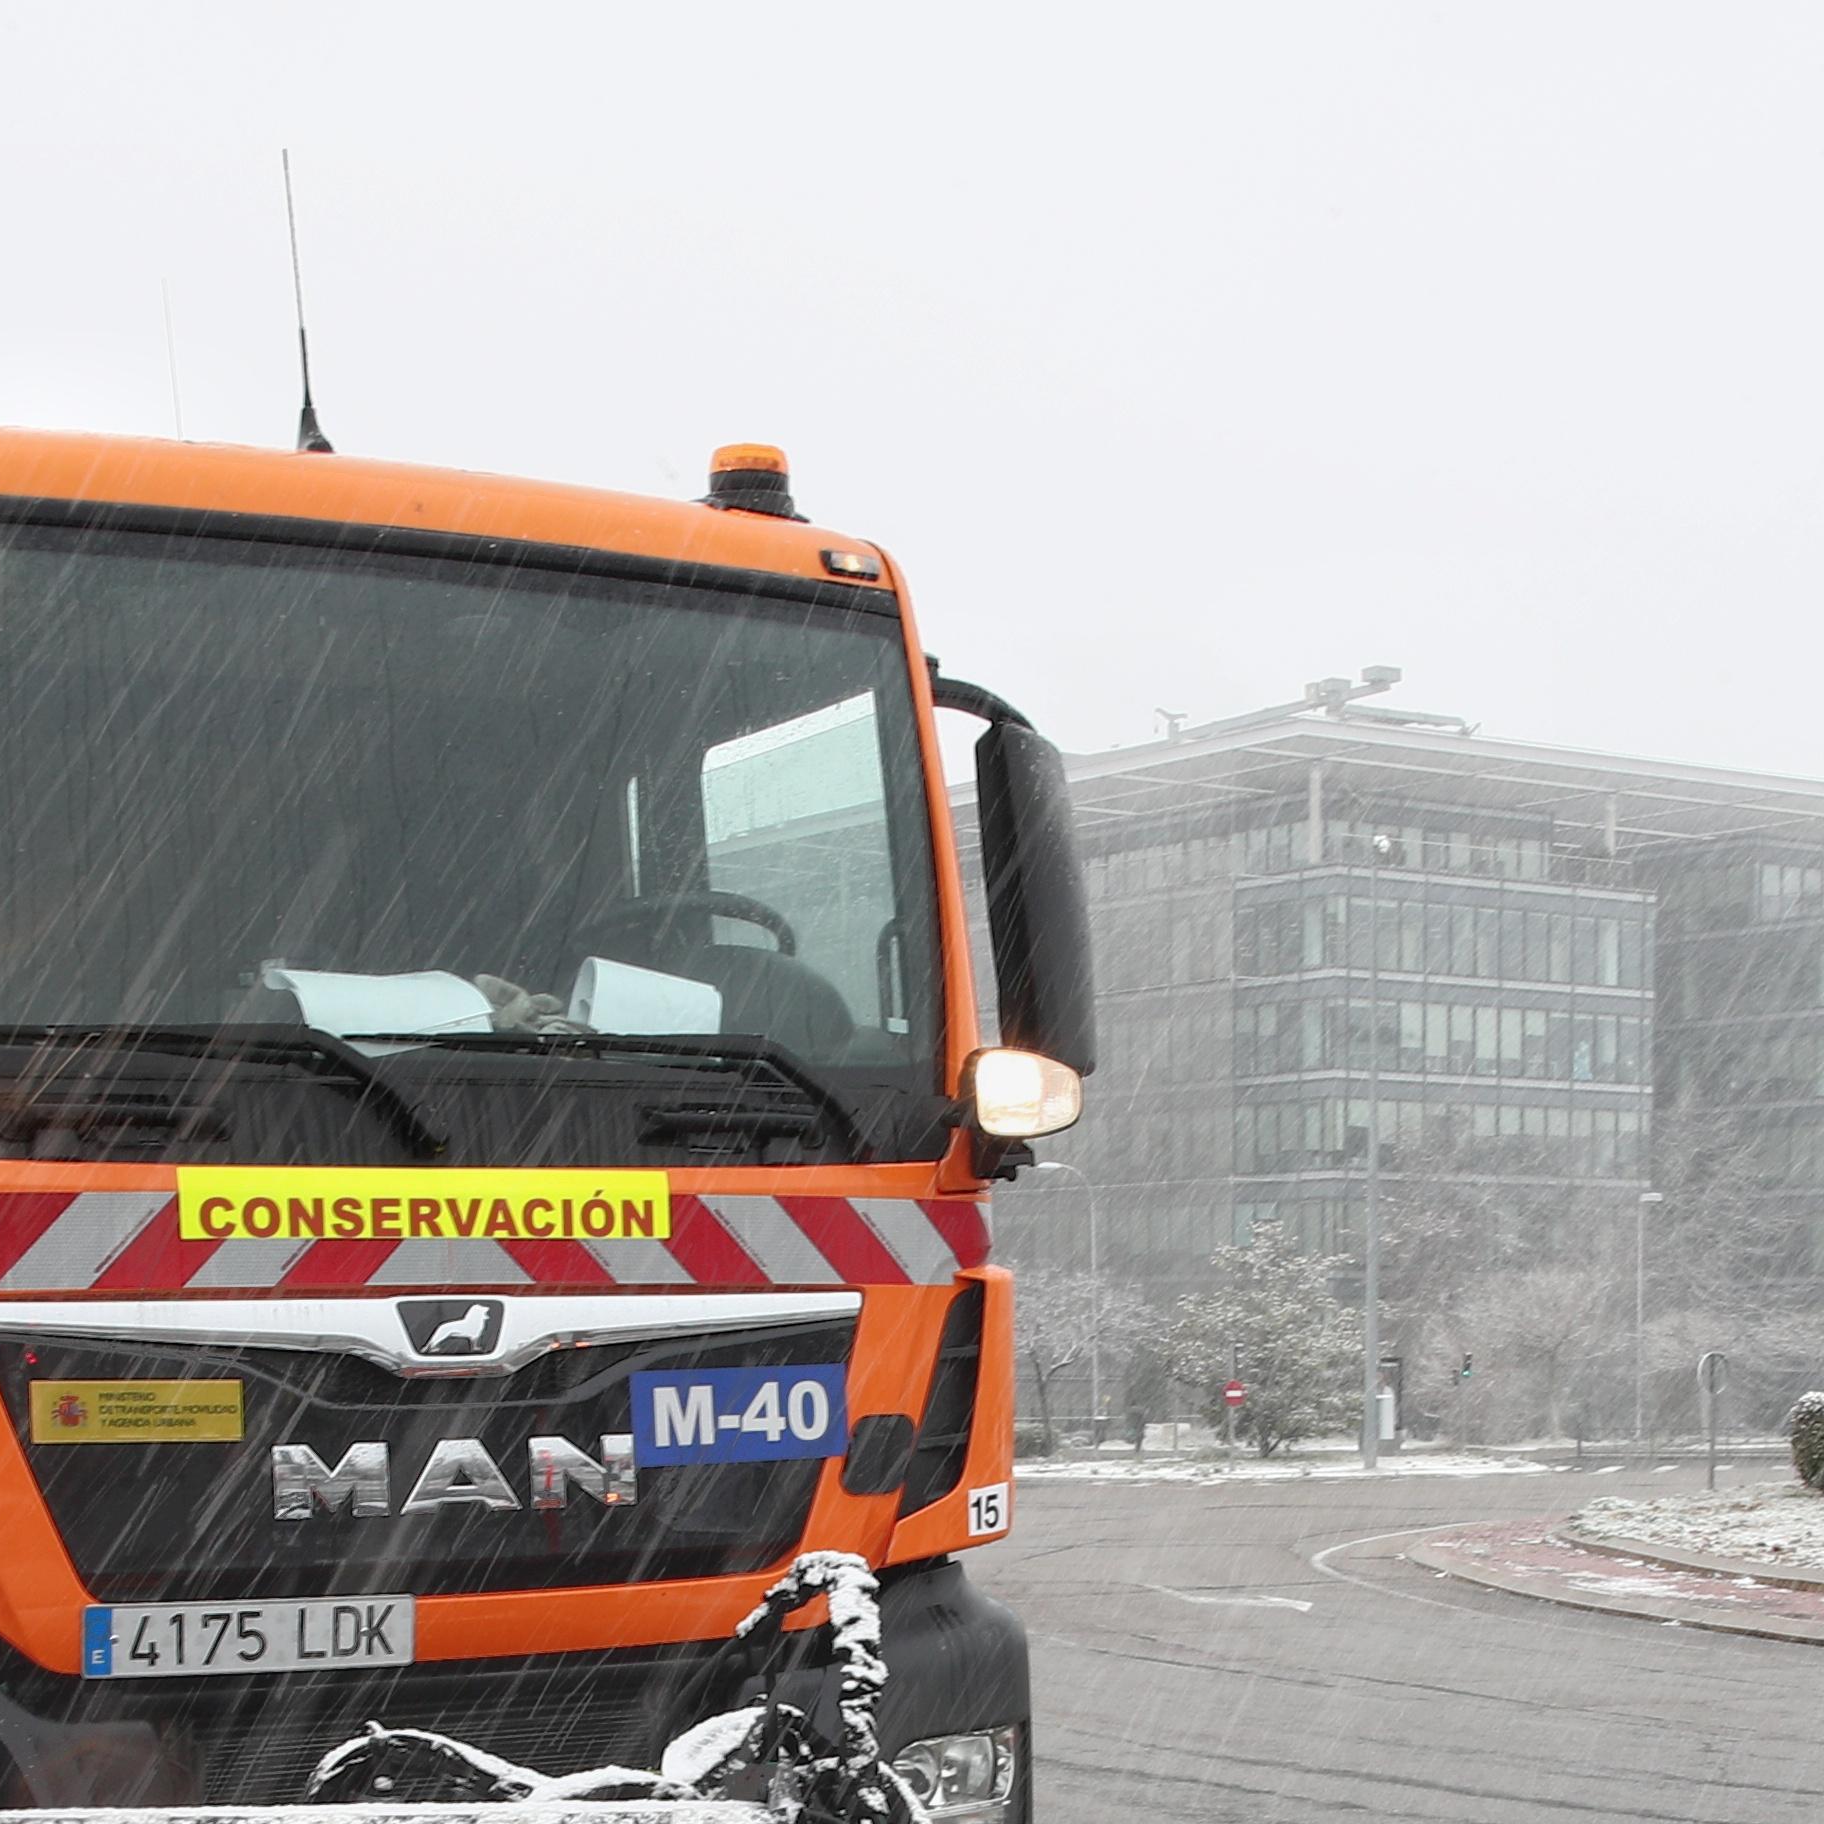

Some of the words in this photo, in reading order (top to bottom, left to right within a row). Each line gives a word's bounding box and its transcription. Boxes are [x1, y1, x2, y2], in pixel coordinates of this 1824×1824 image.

[199, 1190, 655, 1238] CONSERVACIÓN
[652, 1380, 830, 1448] M-40
[271, 1434, 638, 1520] MAN
[970, 1494, 999, 1530] 15
[91, 1650, 106, 1665] E
[129, 1609, 267, 1667] 4175
[297, 1604, 396, 1660] LDK
